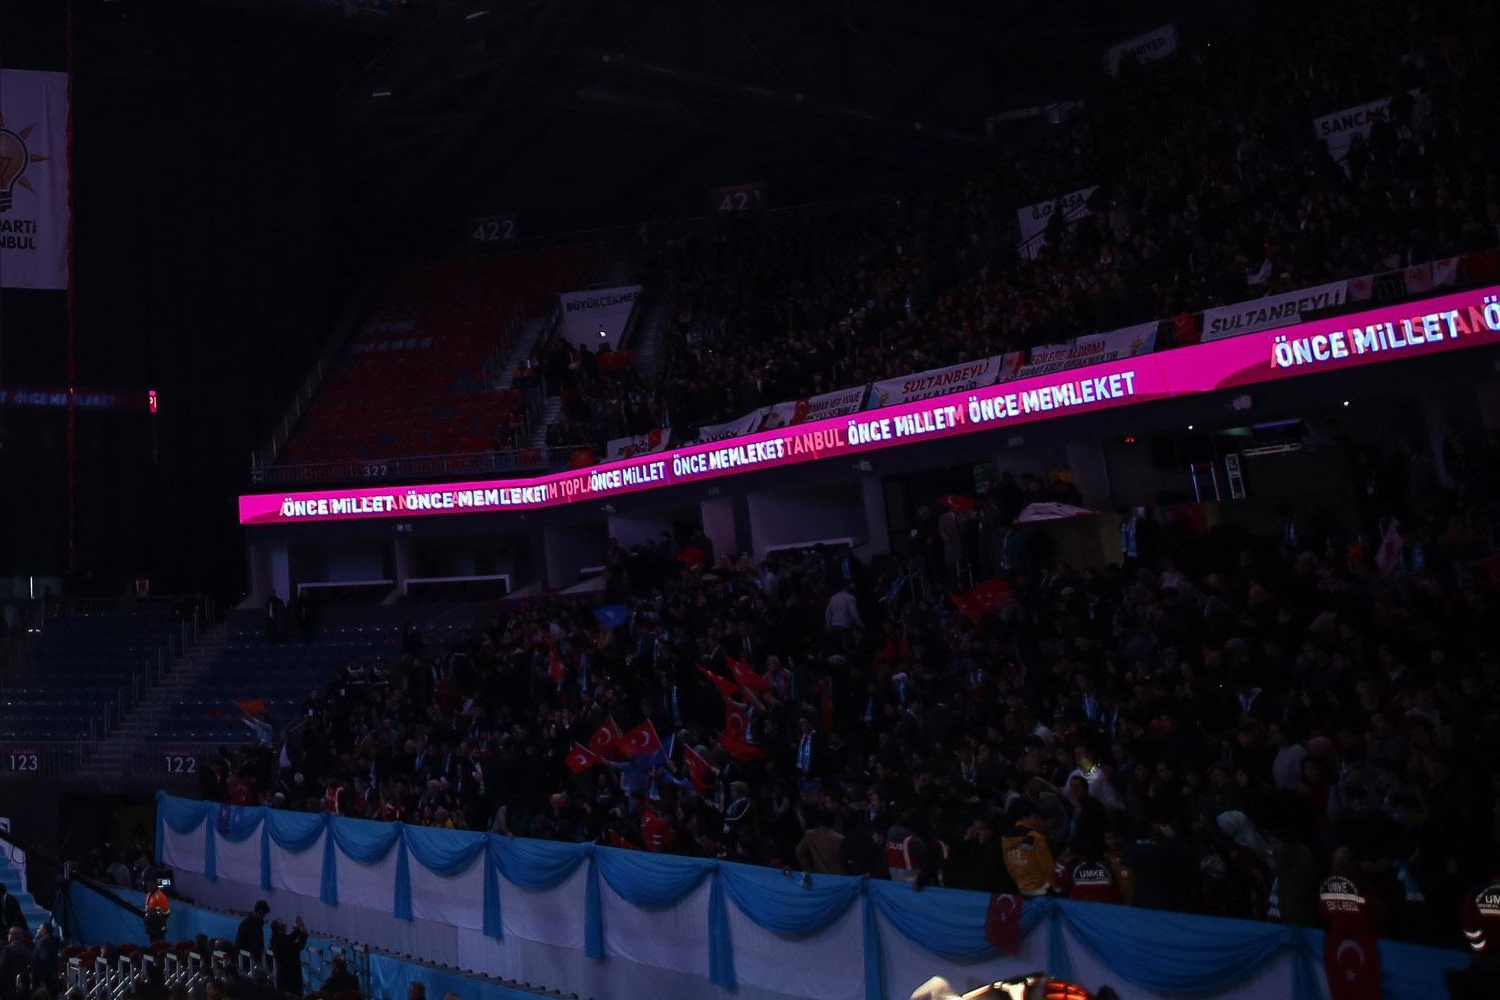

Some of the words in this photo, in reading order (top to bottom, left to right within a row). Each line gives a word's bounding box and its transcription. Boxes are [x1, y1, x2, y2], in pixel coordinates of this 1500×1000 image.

[1275, 335, 1349, 367] ÖNCE
[968, 397, 1020, 423] ÖNCE
[1022, 372, 1136, 414] MEMLEKET
[847, 419, 892, 445] ÖNCE
[673, 454, 708, 476] ÖNCE
[708, 438, 784, 470] MEMLEKET
[363, 465, 388, 477] 322
[591, 470, 622, 492] ÖNCE
[283, 497, 329, 517] ÖNCE
[406, 490, 454, 510] ÖNCE
[458, 485, 547, 507] MEMLEKET
[9, 754, 38, 771] 123
[165, 756, 197, 773] 122
